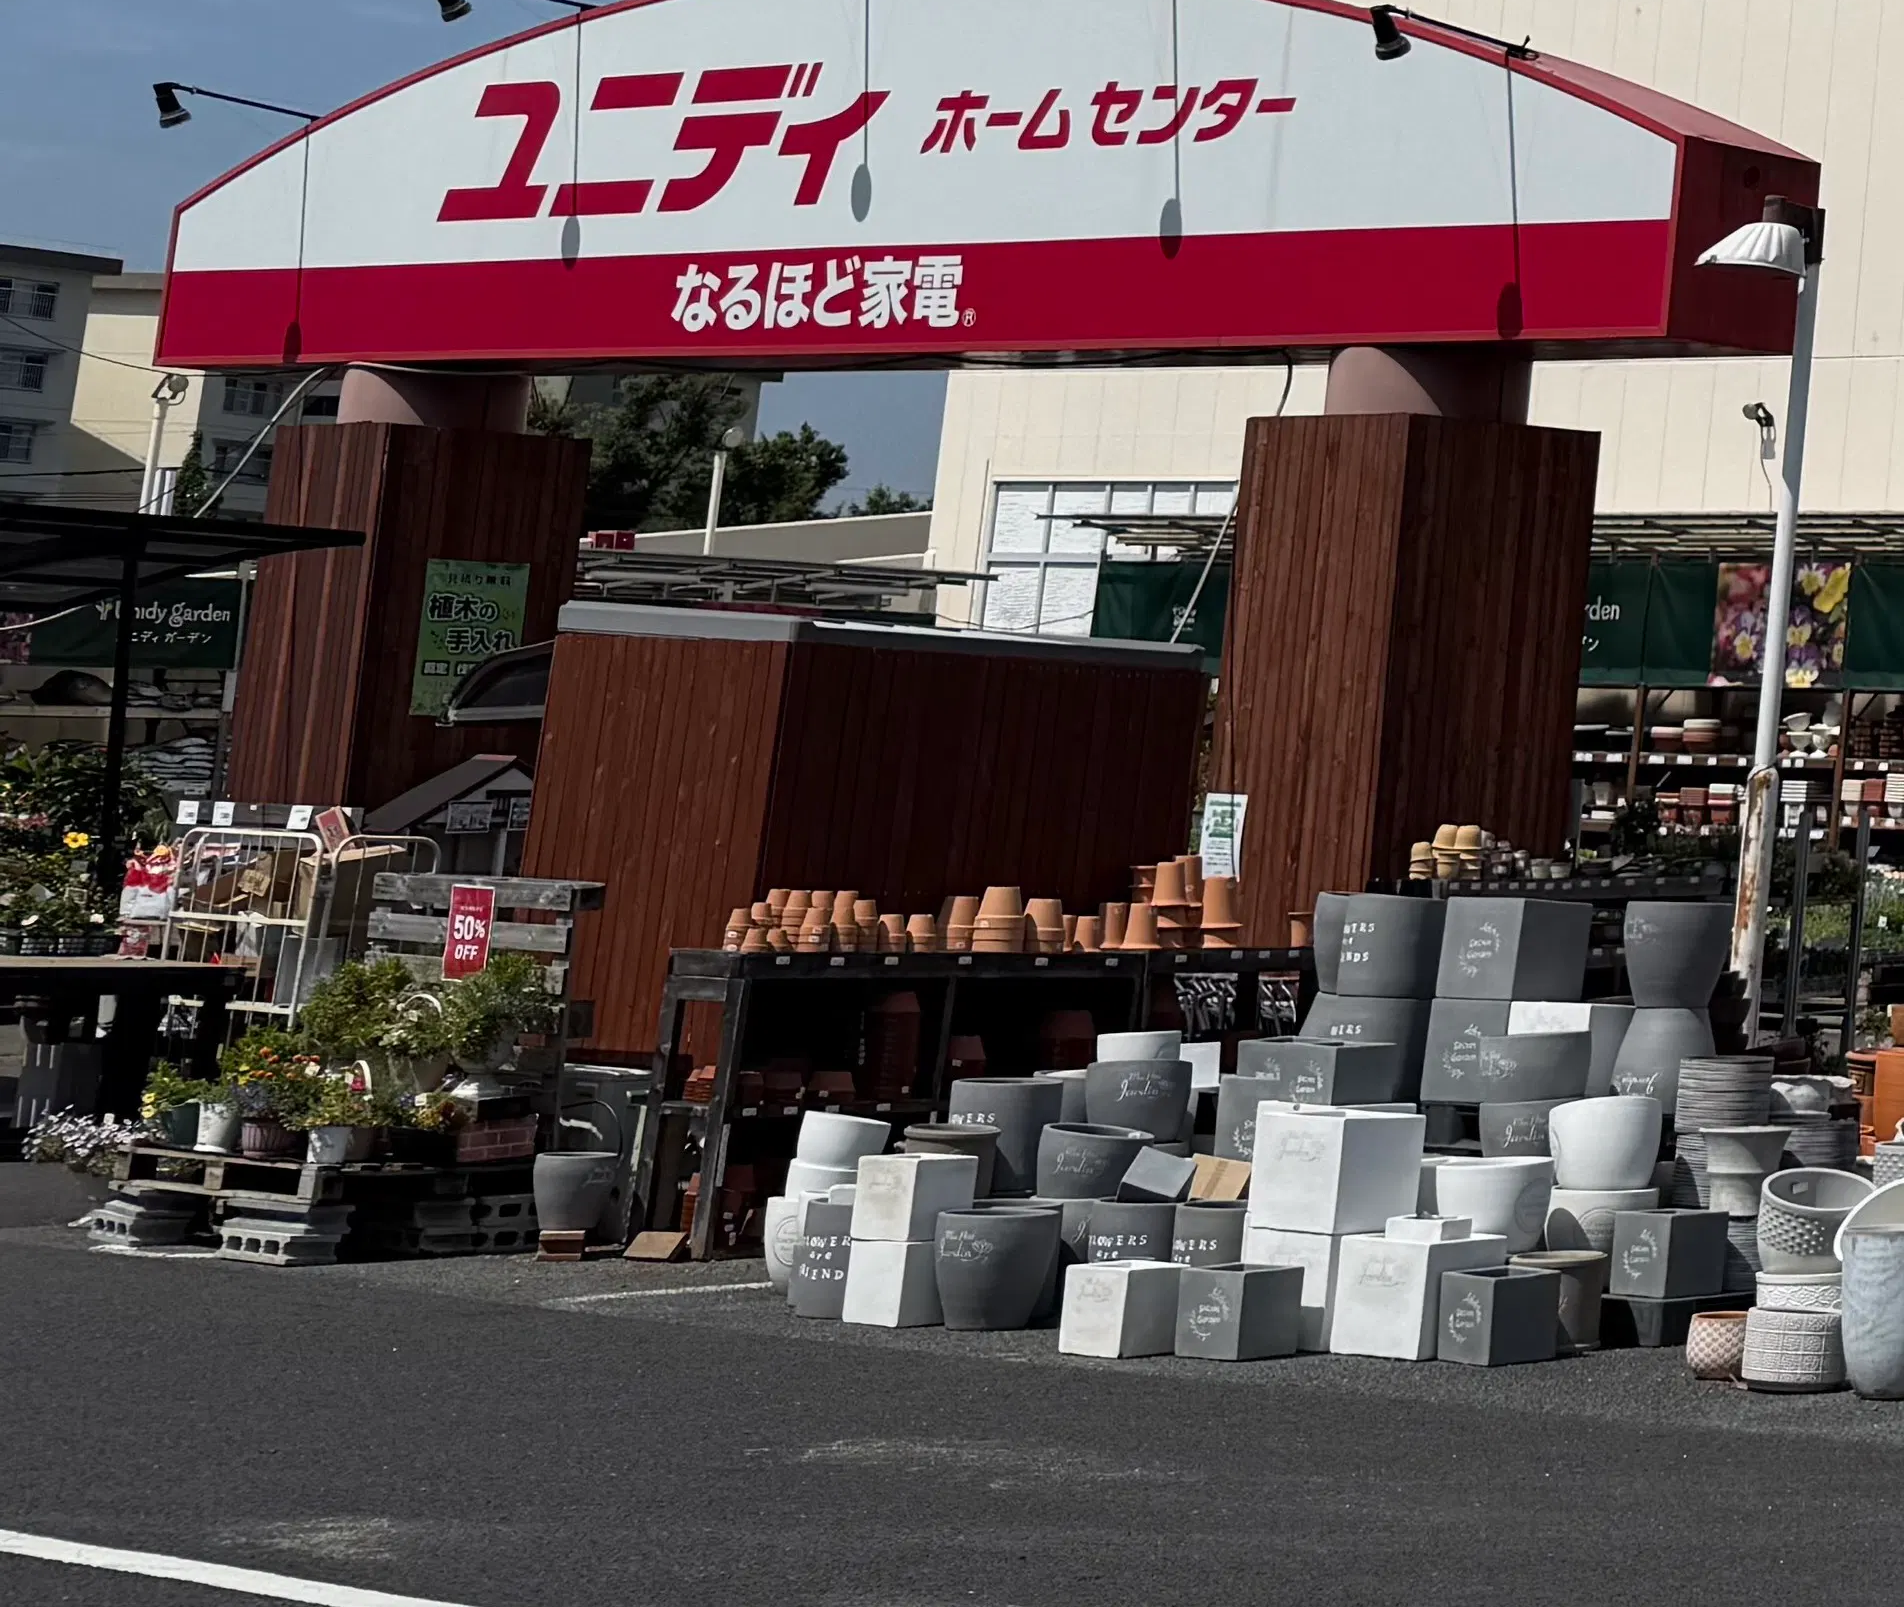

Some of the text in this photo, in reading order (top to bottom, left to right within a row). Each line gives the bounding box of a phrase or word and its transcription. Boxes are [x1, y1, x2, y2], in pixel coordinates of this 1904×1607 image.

[436, 62, 890, 222] ユニディ
[671, 255, 965, 332] なるほど家電
[168, 602, 231, 628] garden
[427, 593, 499, 621] 植木の
[164, 631, 213, 644] ガーデン
[445, 628, 515, 654] 手入れ
[453, 914, 486, 941] 50%
[454, 943, 479, 961] OFF
